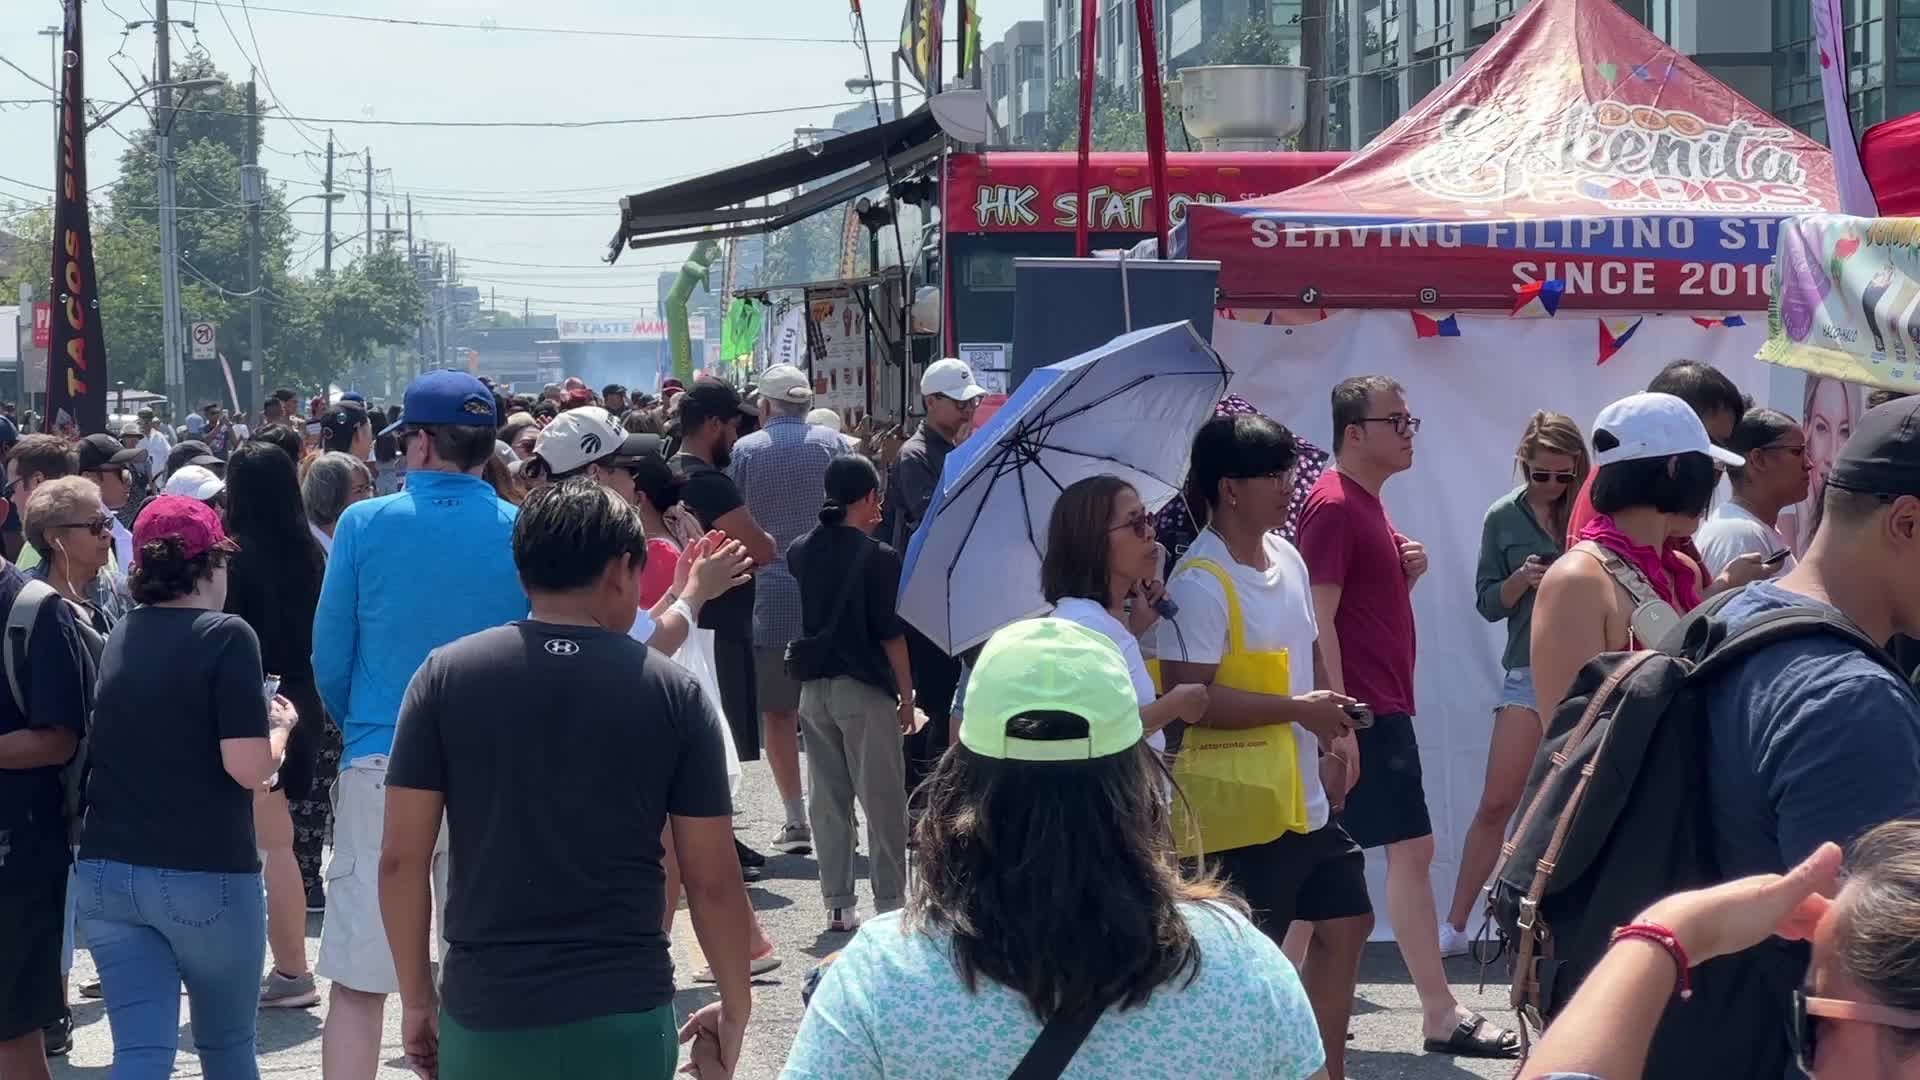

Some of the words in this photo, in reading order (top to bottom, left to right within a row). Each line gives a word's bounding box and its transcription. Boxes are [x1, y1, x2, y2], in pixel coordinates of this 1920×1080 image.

[973, 184, 1039, 227] HK
[1053, 184, 1226, 230] STATO
[1251, 219, 1462, 248] SERVING
[1487, 217, 1695, 249] FILIPINO
[1512, 261, 1655, 296] SINCE
[65, 228, 87, 398] TACOS
